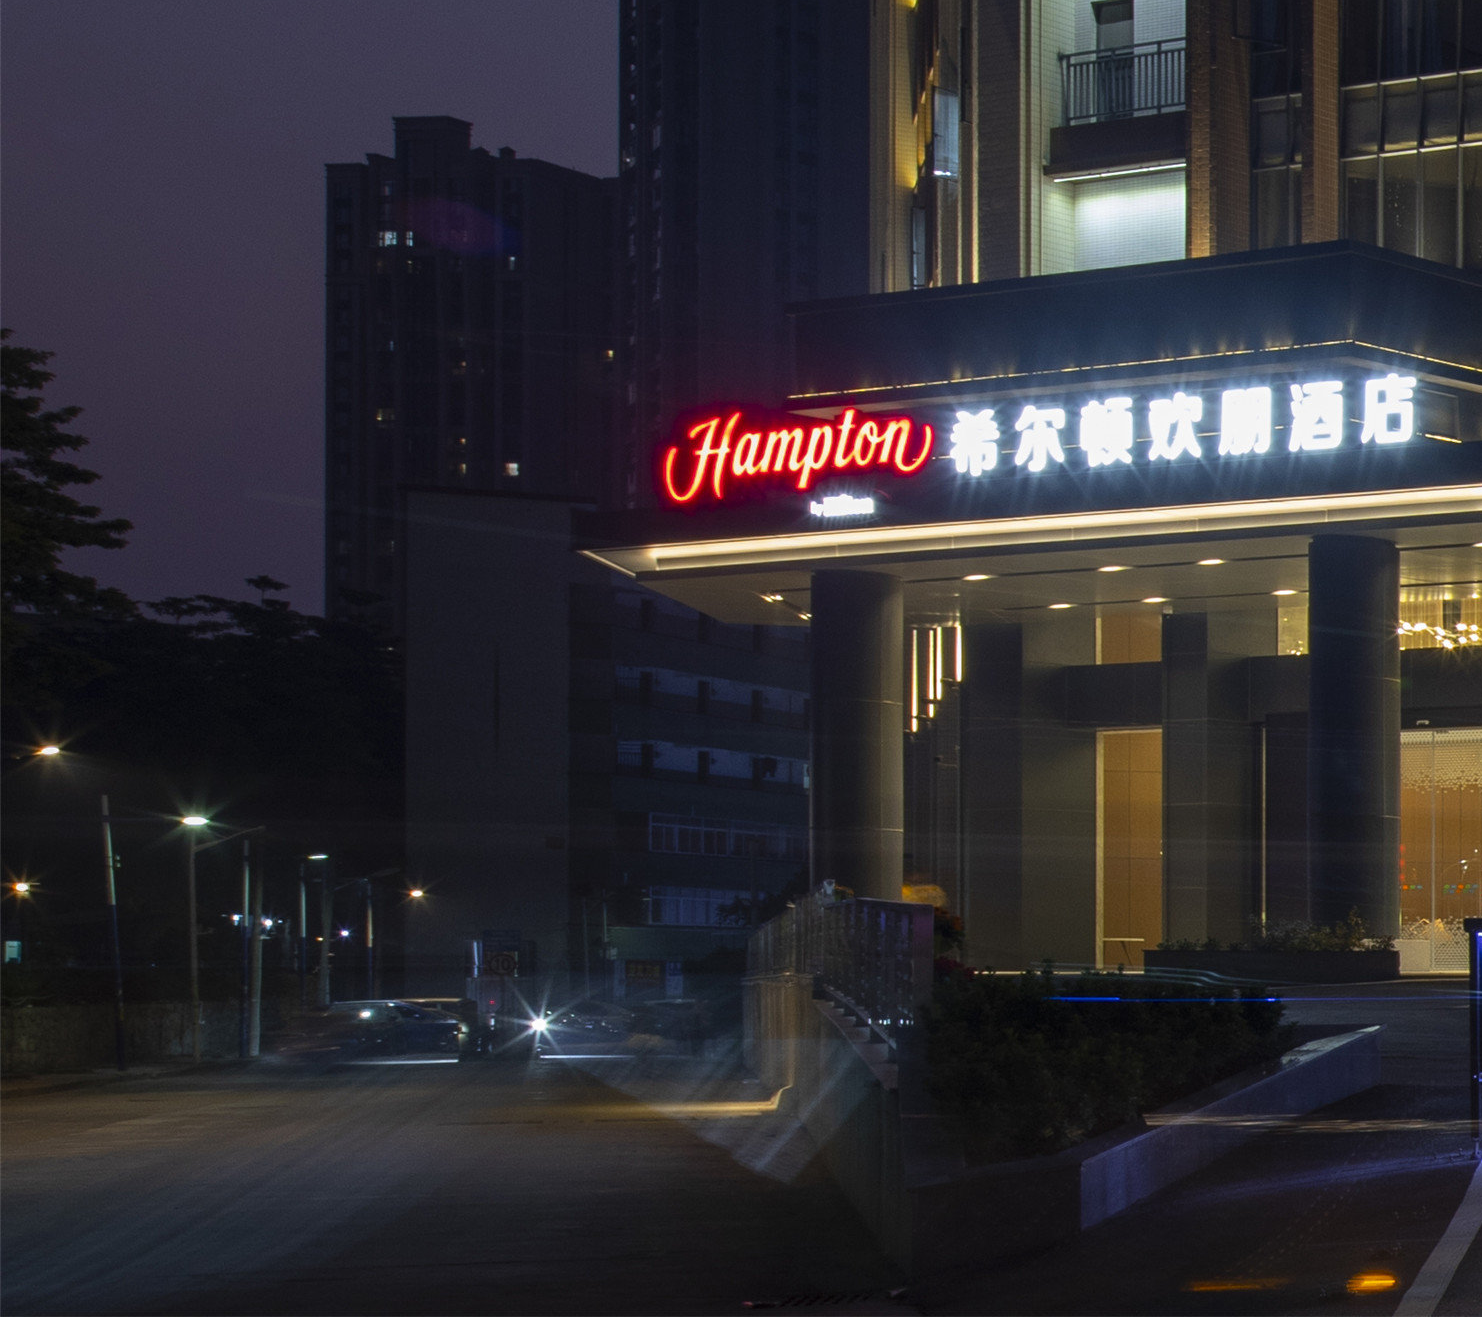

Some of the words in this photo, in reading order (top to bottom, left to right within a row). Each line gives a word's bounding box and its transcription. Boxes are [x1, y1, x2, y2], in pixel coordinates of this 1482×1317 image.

[665, 406, 932, 504] Hampton
[949, 373, 1418, 477] 希尔顿欢朋酒店
